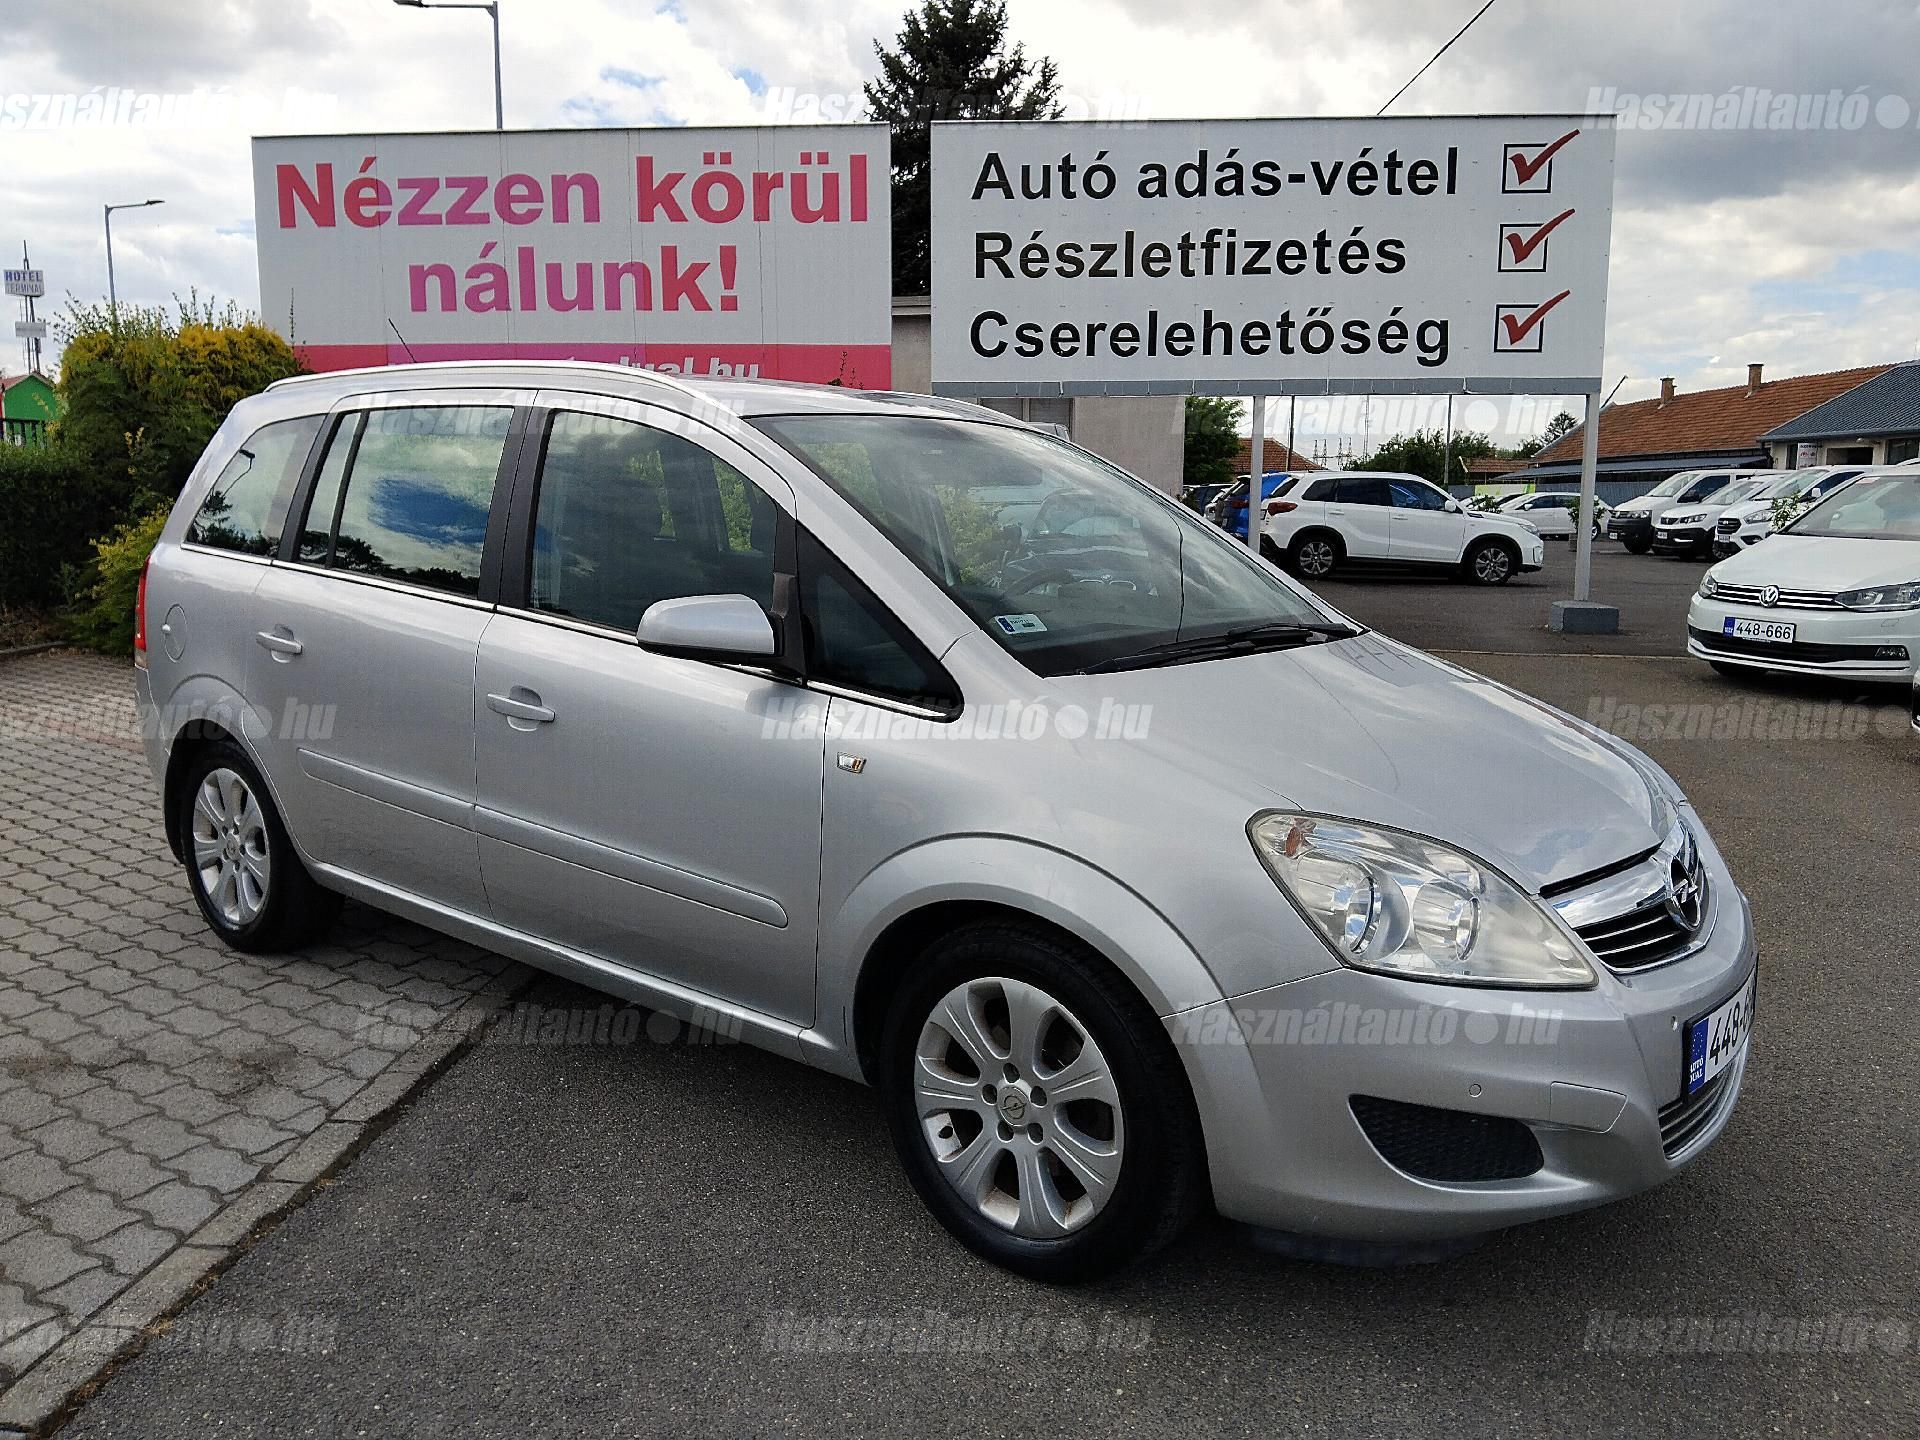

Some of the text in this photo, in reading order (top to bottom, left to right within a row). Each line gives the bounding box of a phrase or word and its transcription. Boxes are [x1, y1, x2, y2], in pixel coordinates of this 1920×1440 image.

[276, 151, 869, 229] Nézzen körül
[971, 146, 1458, 200] Autó adás-vétel
[5, 271, 41, 281] HOTEL
[409, 242, 738, 313] nálunk!
[975, 225, 1406, 279] Részletfizetés
[970, 305, 1450, 368] Cserelehetőség
[1736, 622, 1792, 639] 448-666
